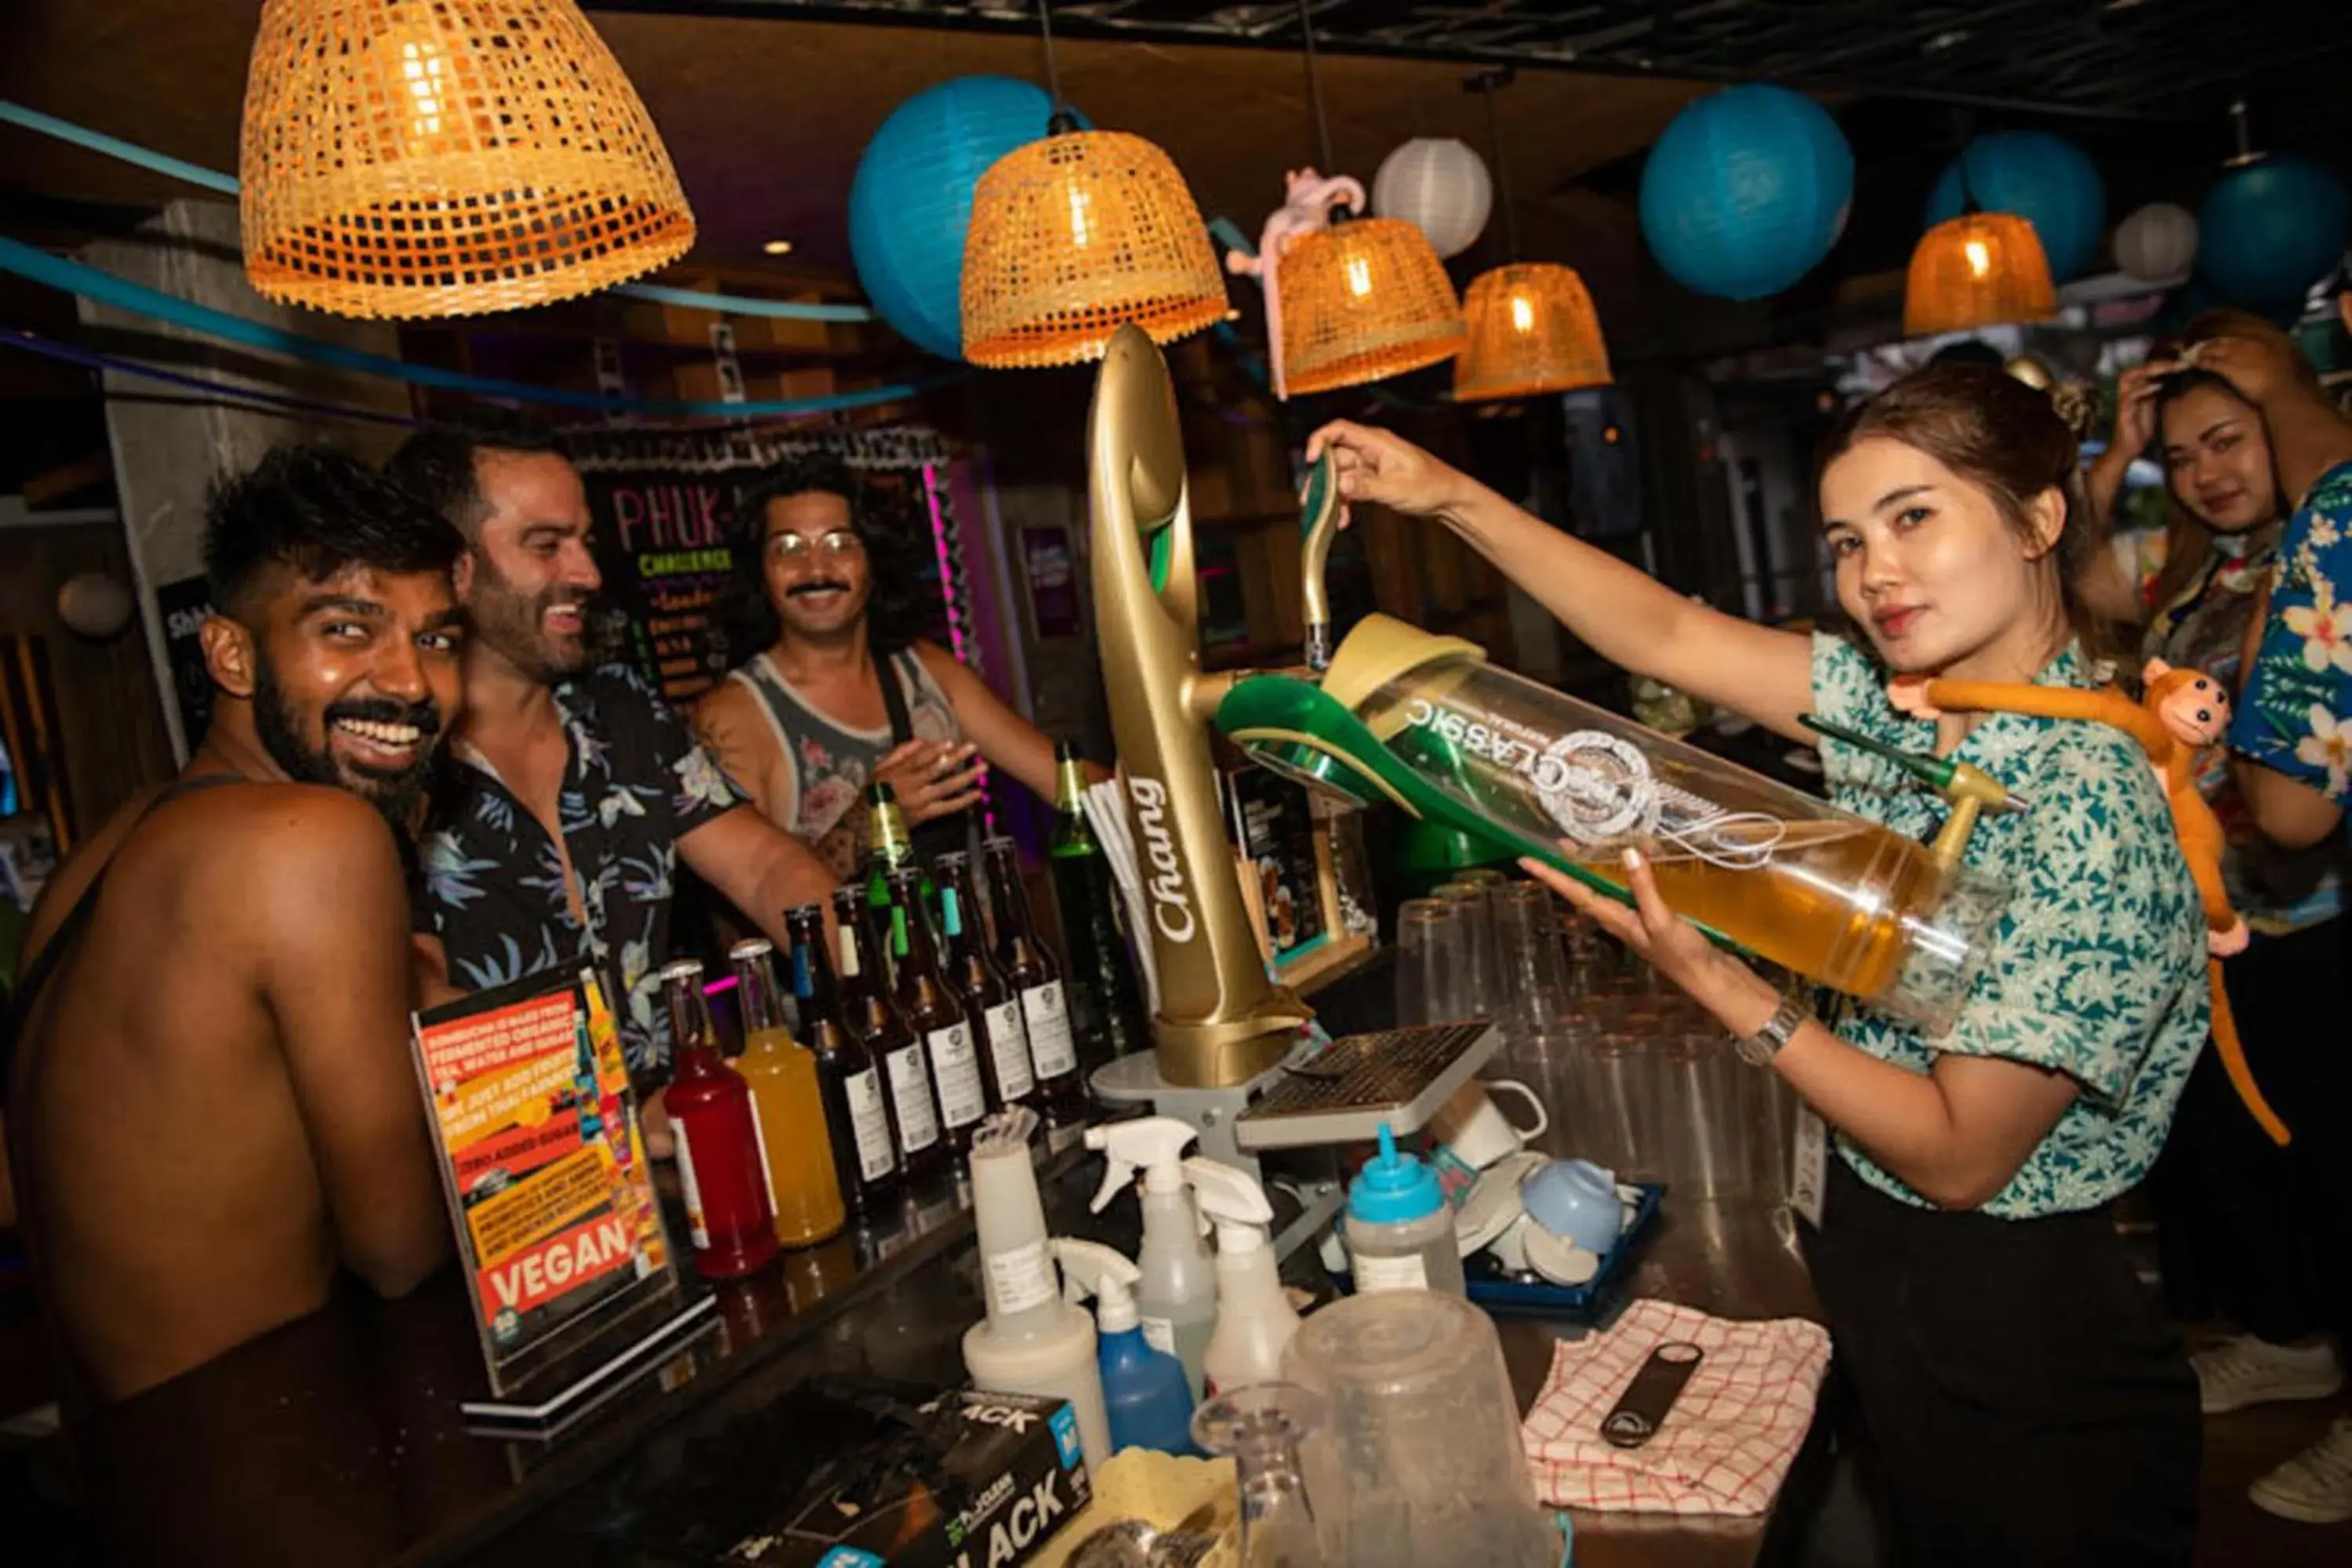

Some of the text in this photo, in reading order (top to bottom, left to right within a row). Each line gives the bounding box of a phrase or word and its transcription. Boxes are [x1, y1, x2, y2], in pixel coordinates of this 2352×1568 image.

[1406, 698, 1569, 793] CLASSIC
[1128, 776, 1196, 944] Chang
[490, 1218, 626, 1308] VEGAN
